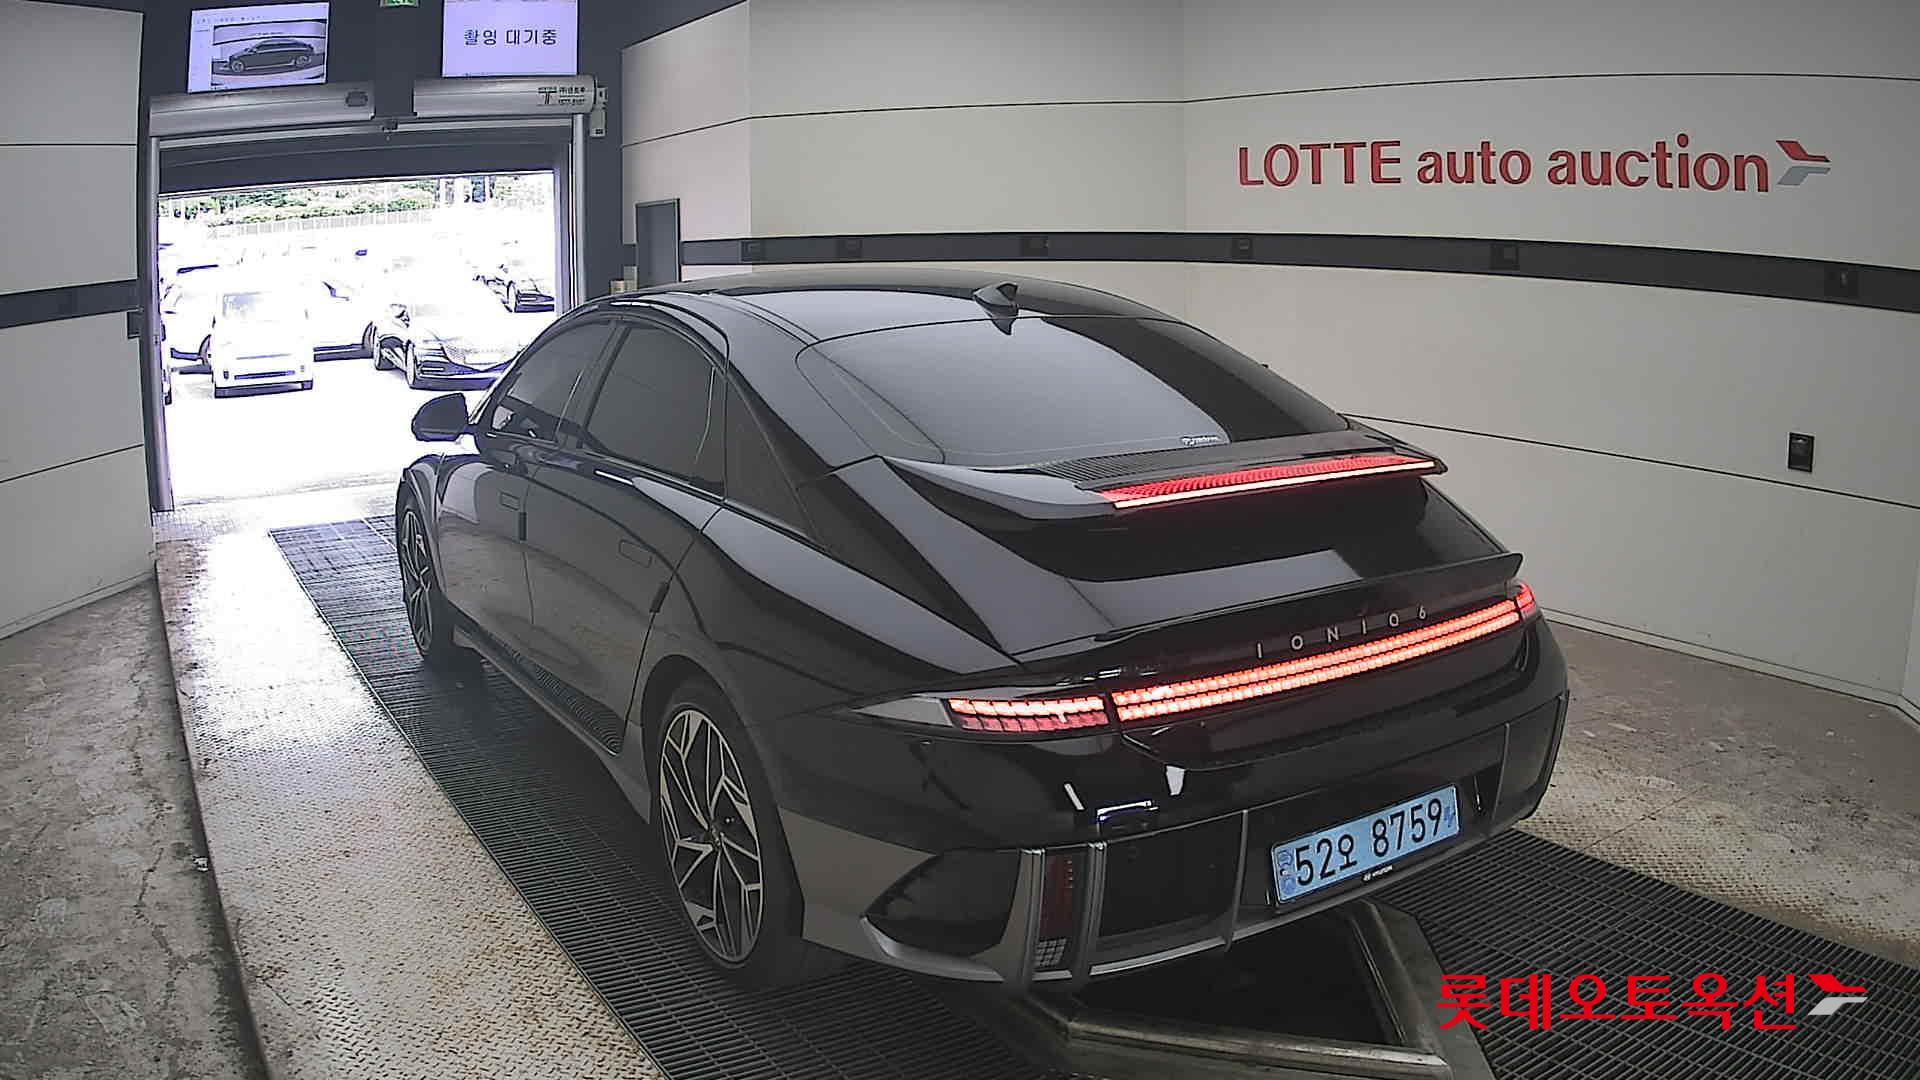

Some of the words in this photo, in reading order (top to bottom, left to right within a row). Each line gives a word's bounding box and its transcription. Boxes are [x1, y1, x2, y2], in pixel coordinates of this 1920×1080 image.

[464, 29, 497, 46] 촬영
[505, 29, 557, 46] 대기중
[1239, 140, 1400, 187] LOTTE
[1416, 140, 1532, 186] auto
[1547, 133, 1770, 192] auction
[1295, 834, 1358, 886] 52오
[1372, 798, 1442, 857] 8759
